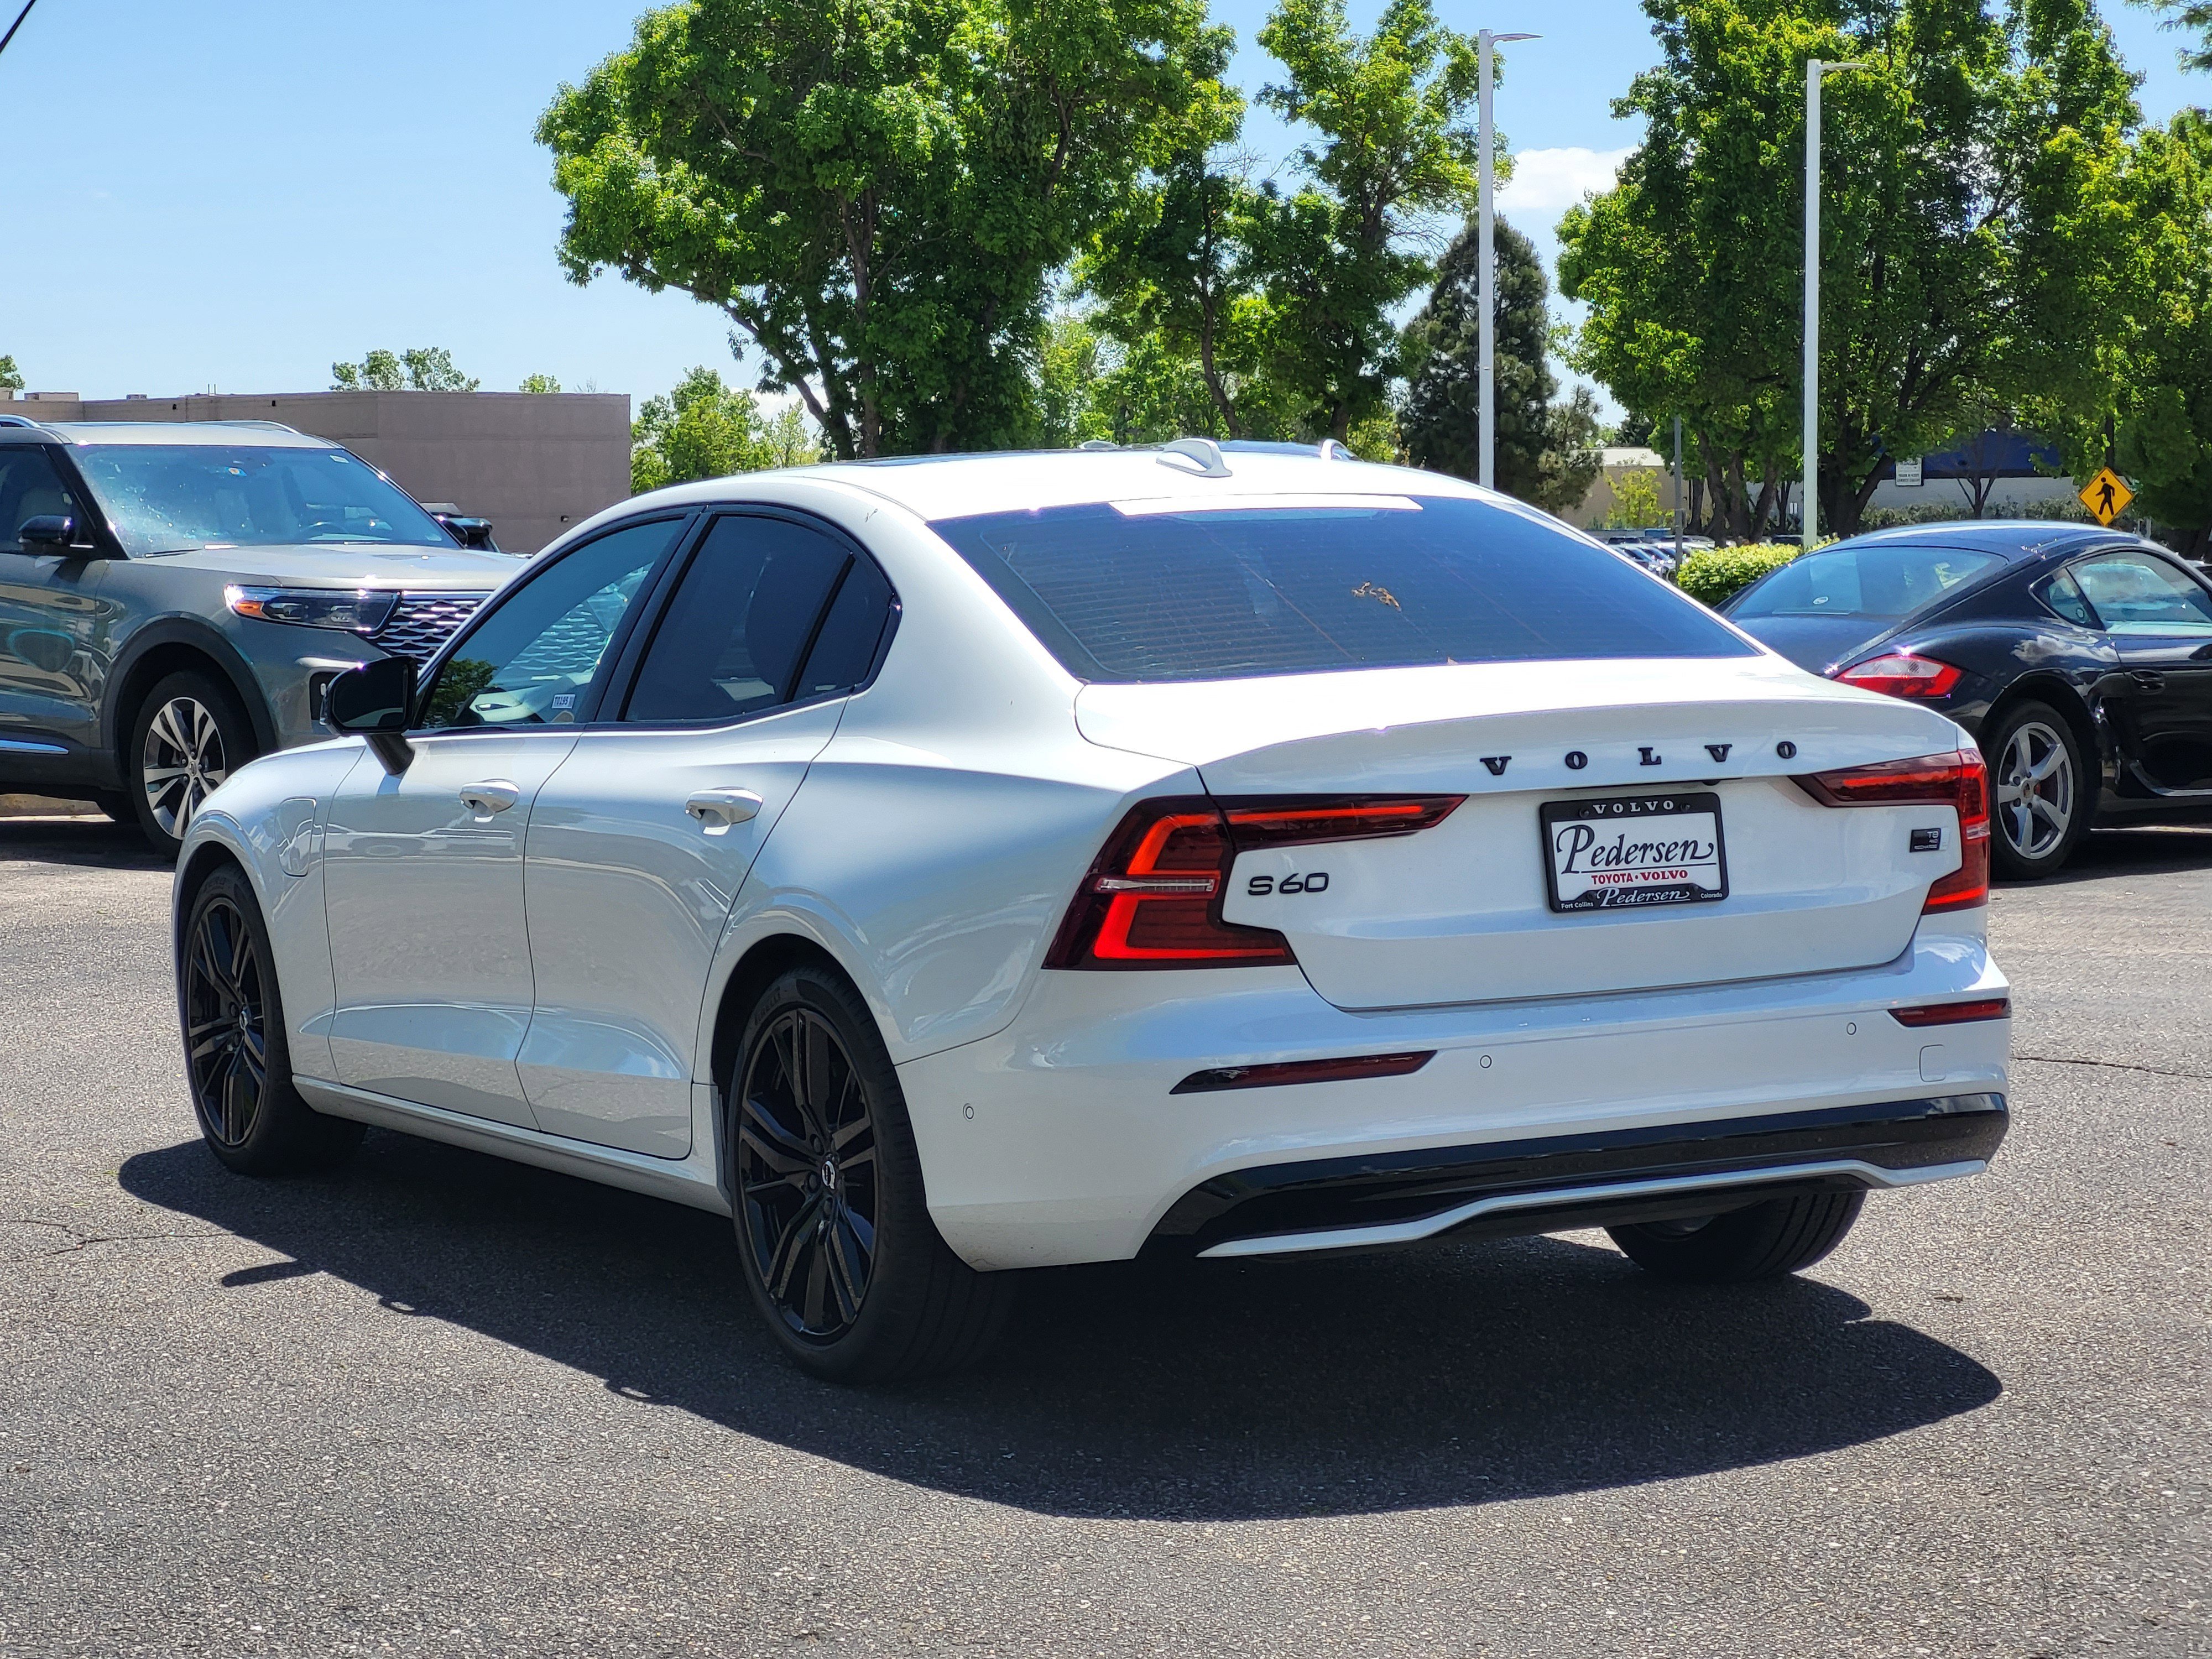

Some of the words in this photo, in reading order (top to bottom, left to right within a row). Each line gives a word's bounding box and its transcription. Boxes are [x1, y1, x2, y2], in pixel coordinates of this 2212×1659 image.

[1480, 740, 1797, 776] VOLVO
[1593, 800, 1674, 814] VOLVO
[1556, 825, 1714, 875] Pedersen
[1248, 872, 1329, 896] S60
[1591, 873, 1634, 885] TOYOTA
[1639, 869, 1688, 881] VOLVO
[1596, 886, 1690, 907] Pedersen
